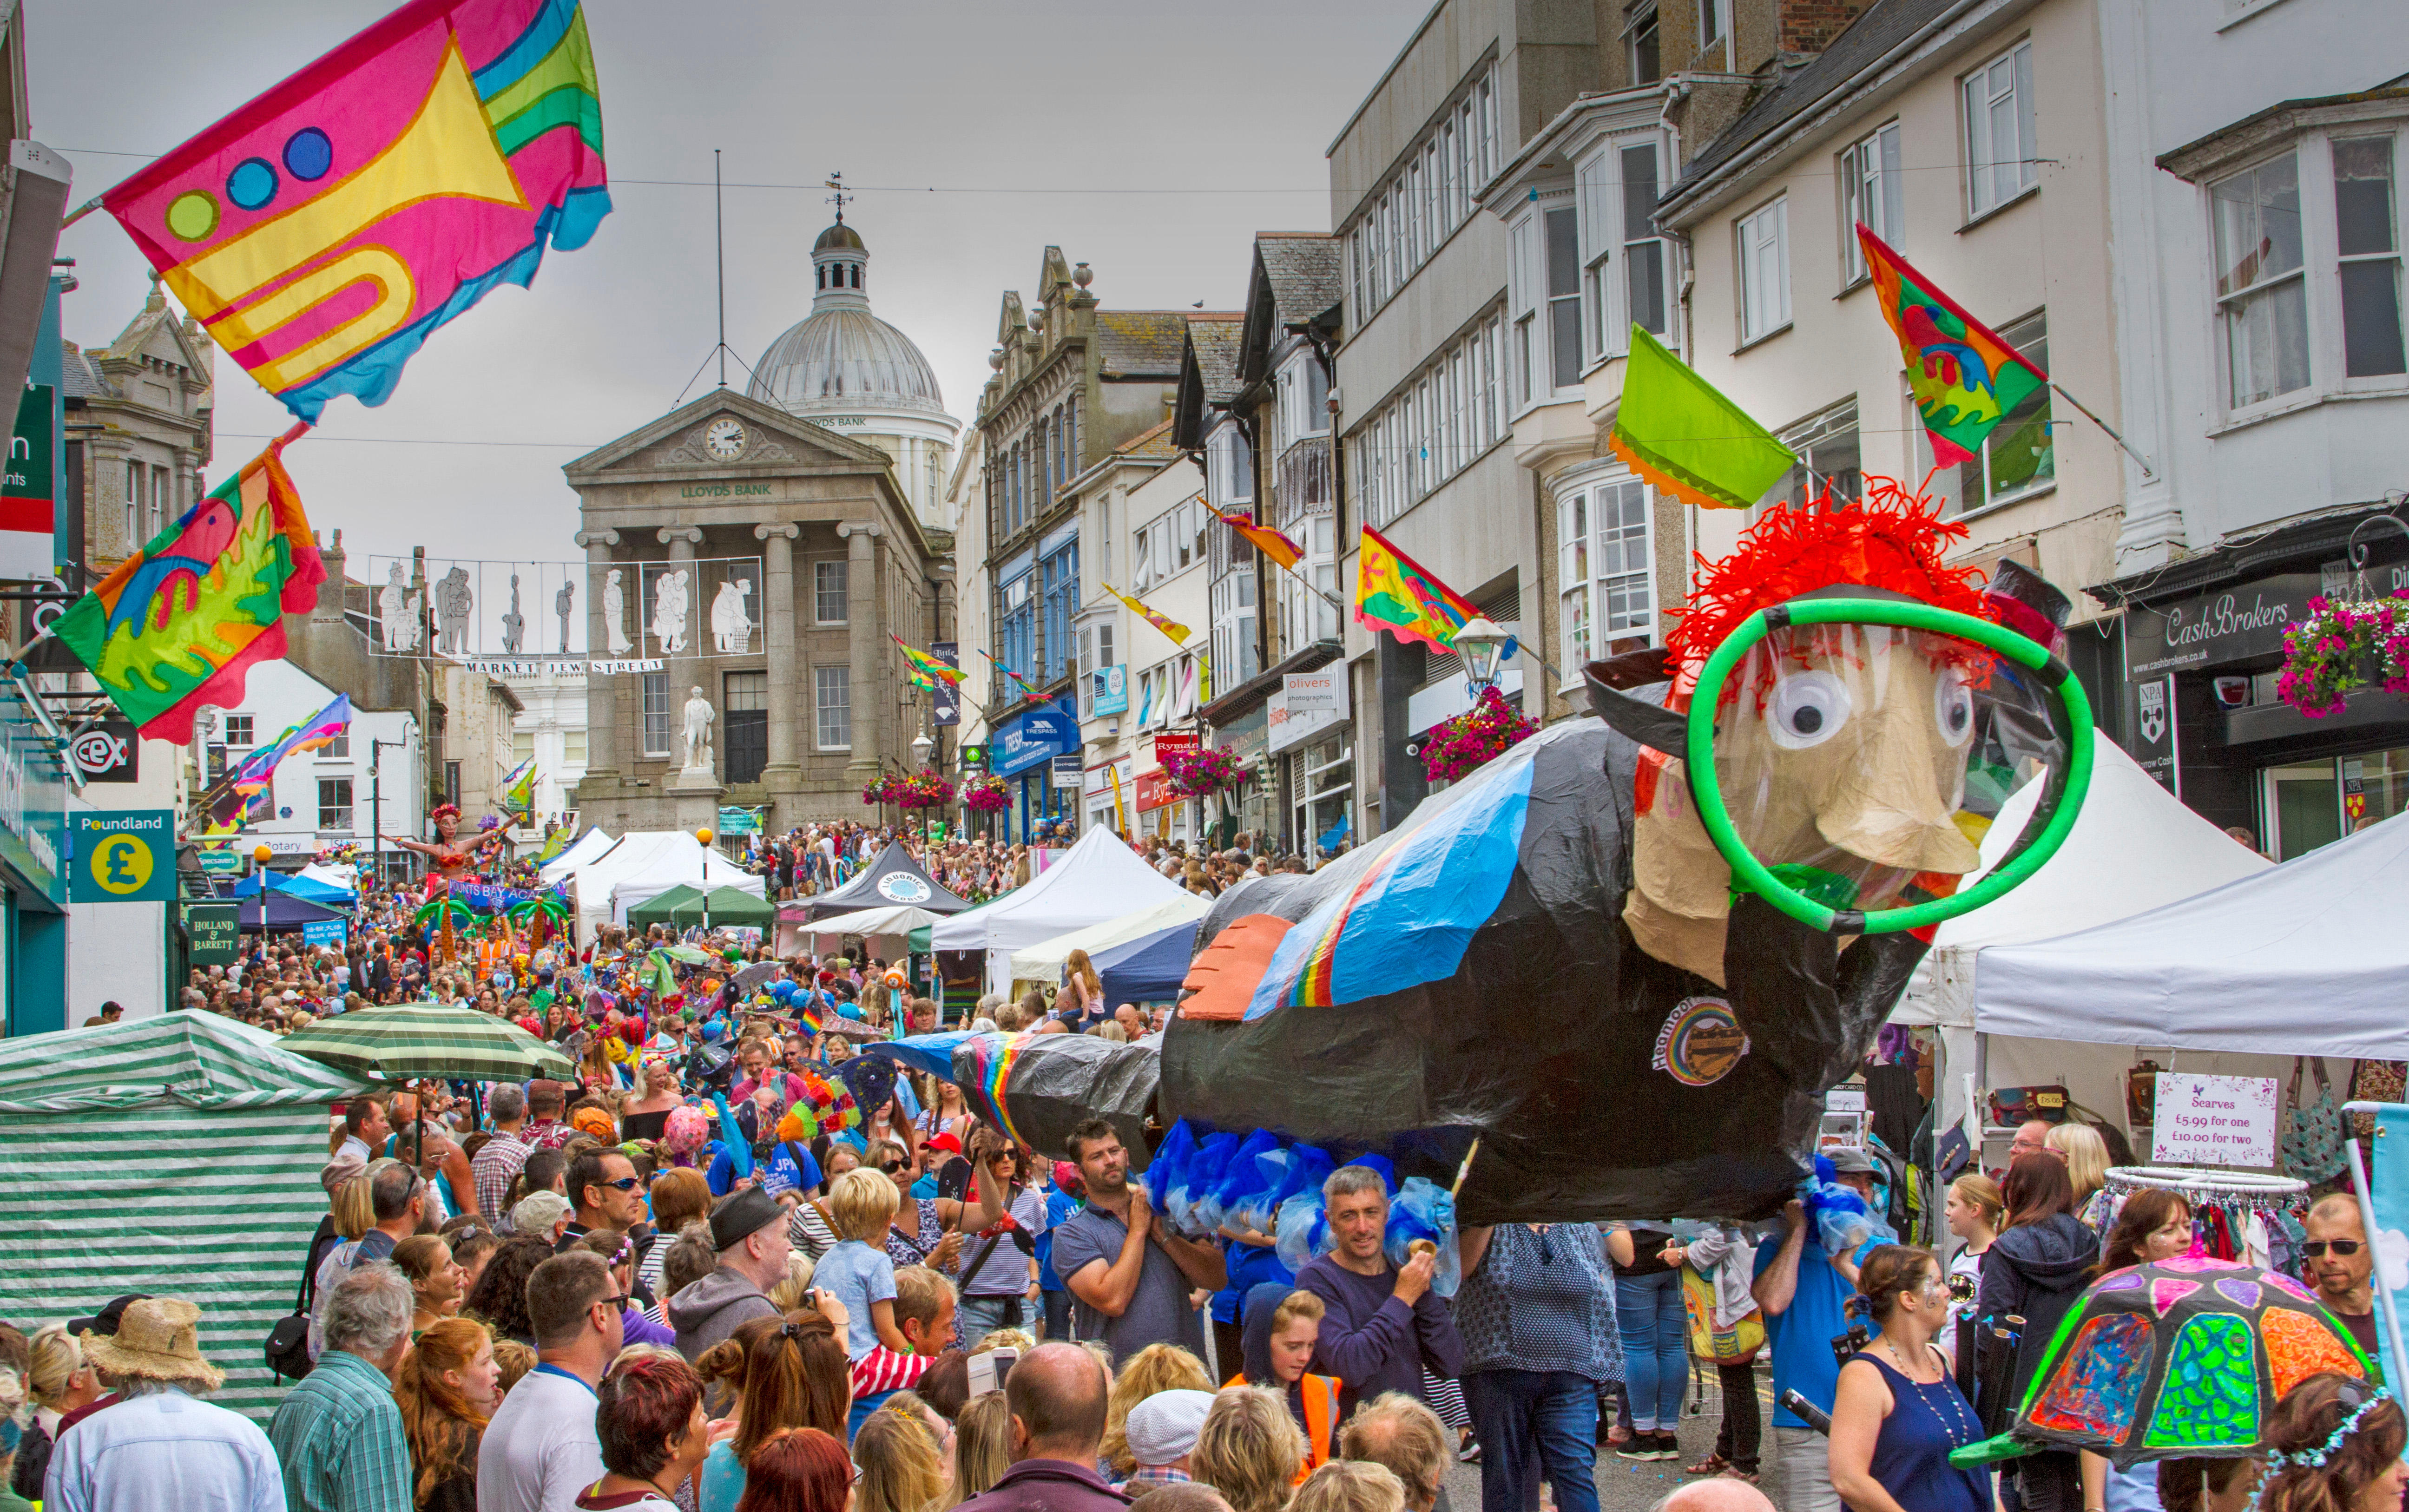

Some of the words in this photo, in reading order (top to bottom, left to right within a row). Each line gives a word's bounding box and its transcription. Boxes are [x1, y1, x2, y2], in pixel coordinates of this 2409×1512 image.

[838, 418, 866, 427] BANK
[681, 485, 731, 498] LLOYDS
[735, 484, 772, 496] BANK
[466, 662, 536, 673] MARKET
[548, 663, 583, 673] JEW
[593, 660, 660, 674] STREET
[2133, 649, 2208, 673] www.cashbrokers.co.uk
[1111, 680, 1121, 689] SALE
[1289, 678, 1330, 689] olivers
[1287, 694, 1333, 703] photographics
[2141, 686, 2162, 702] NPA
[2158, 755, 2173, 767] Cash
[2347, 780, 2362, 792] NPA
[265, 841, 301, 852] Rotary
[106, 843, 136, 885] £
[882, 874, 926, 890] LIQUORICE
[482, 886, 506, 897] BAY
[194, 920, 234, 932] HOLLAND
[210, 930, 219, 940] &
[194, 940, 234, 951] BARRETT
[2192, 1096, 2235, 1109] Scarves
[2175, 1113, 2207, 1128] £5.99
[2211, 1116, 2227, 1126] for
[2231, 1118, 2250, 1127] one
[2172, 1131, 2209, 1142] £10.00
[2212, 1133, 2229, 1143] for
[2232, 1134, 2251, 1144] two
